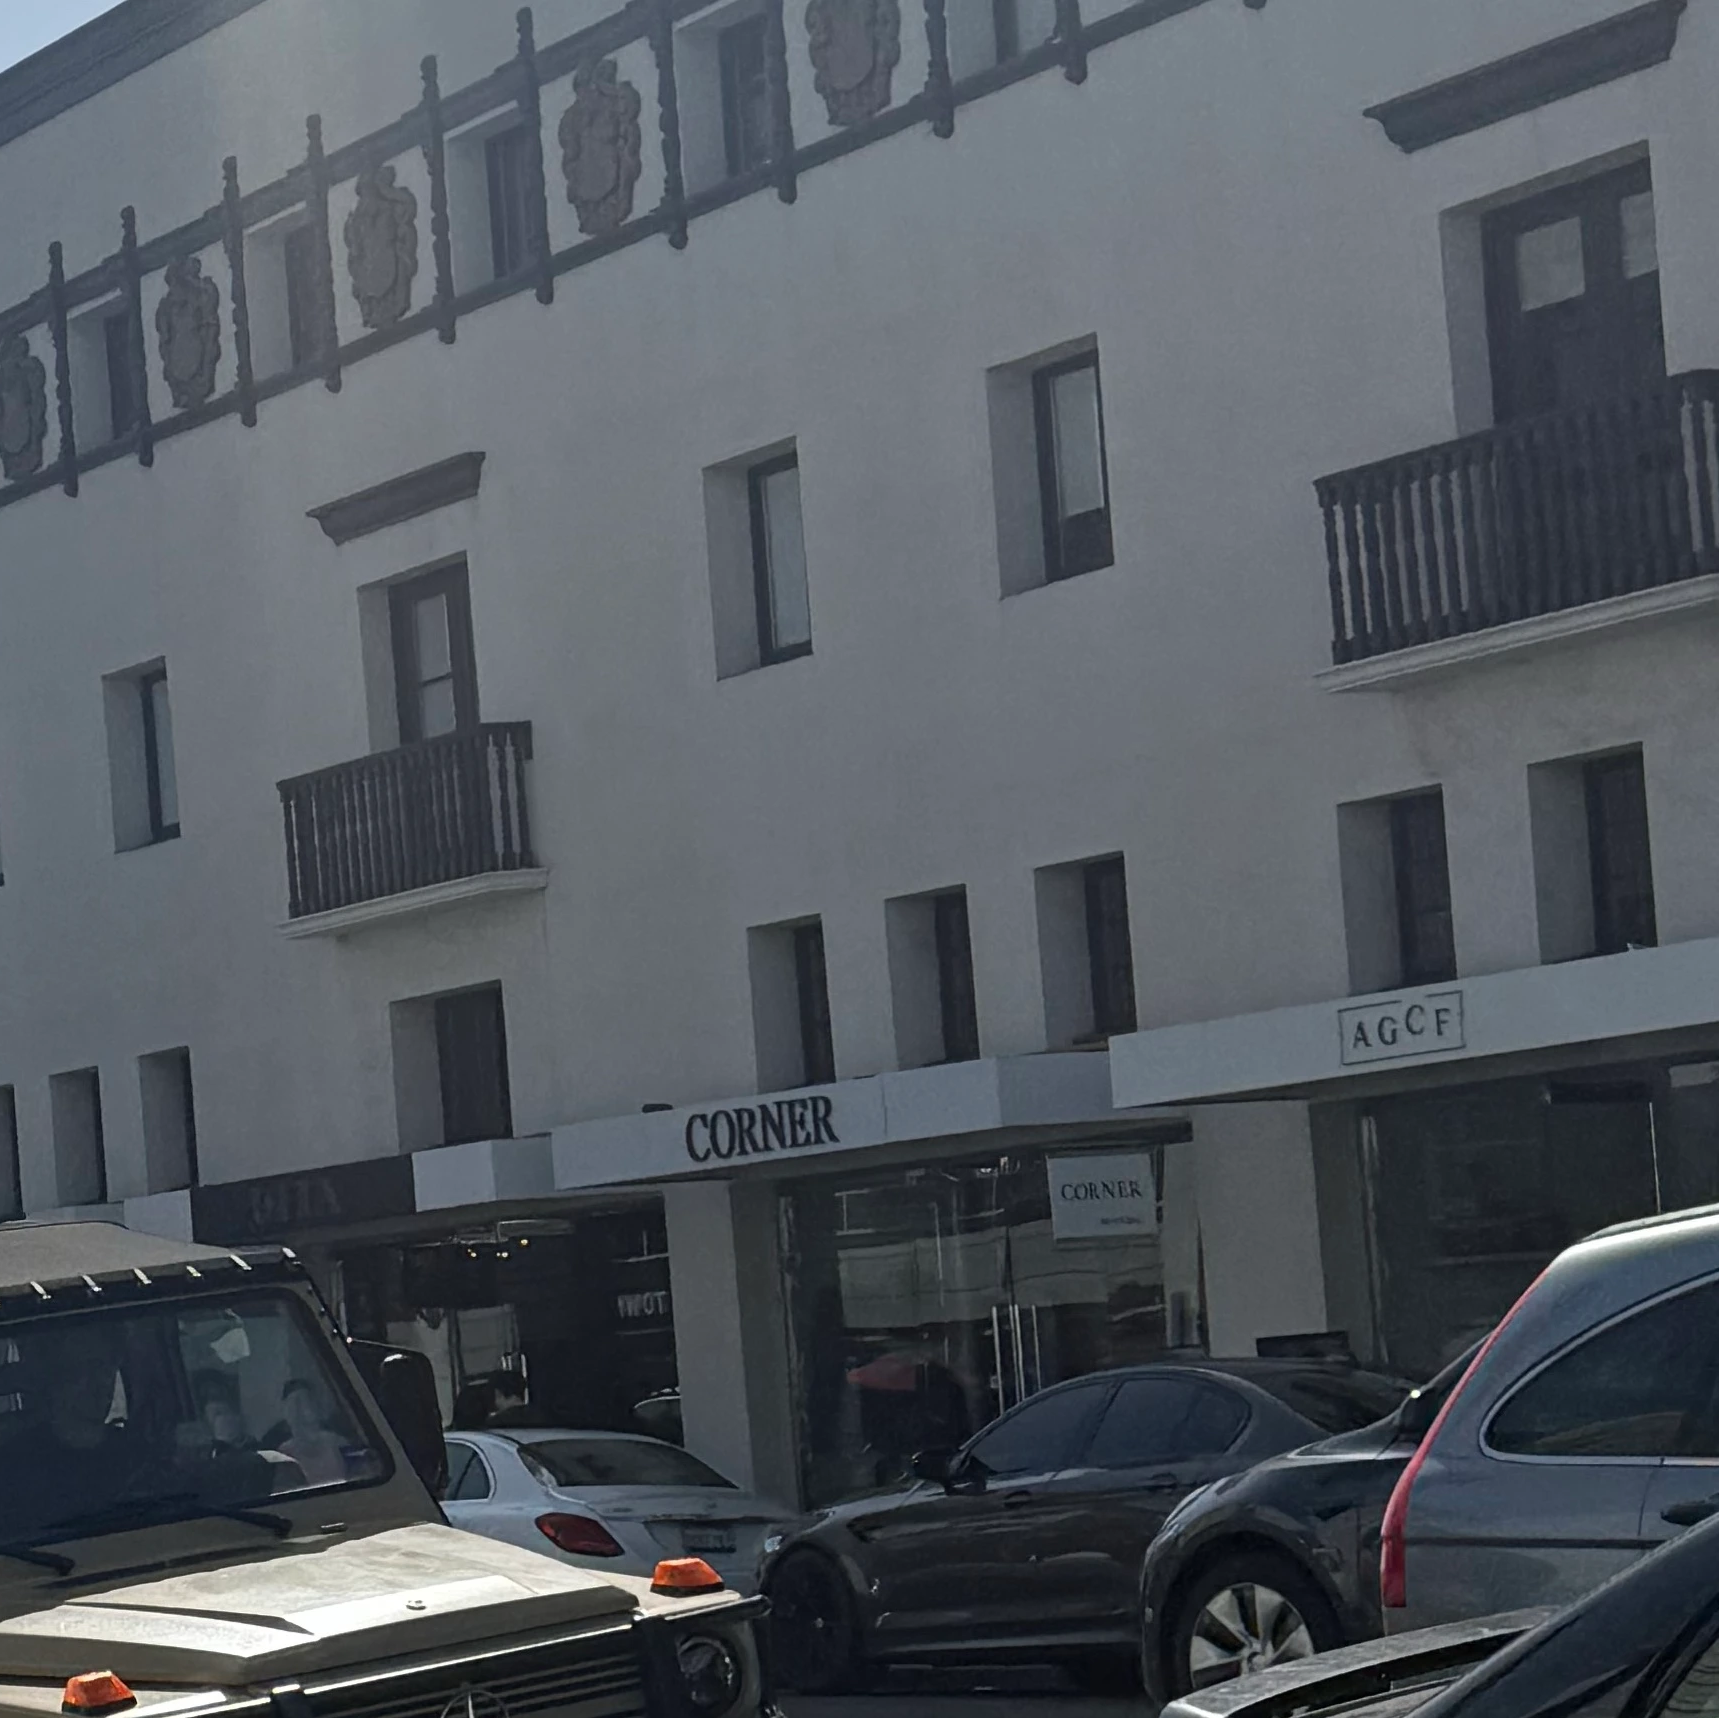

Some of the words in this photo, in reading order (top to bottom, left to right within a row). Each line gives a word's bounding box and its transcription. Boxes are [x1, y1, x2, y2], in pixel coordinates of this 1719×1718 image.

[1353, 1004, 1451, 1049] AGCF
[685, 1095, 840, 1162] CORNER
[1061, 1180, 1142, 1201] CORNER
